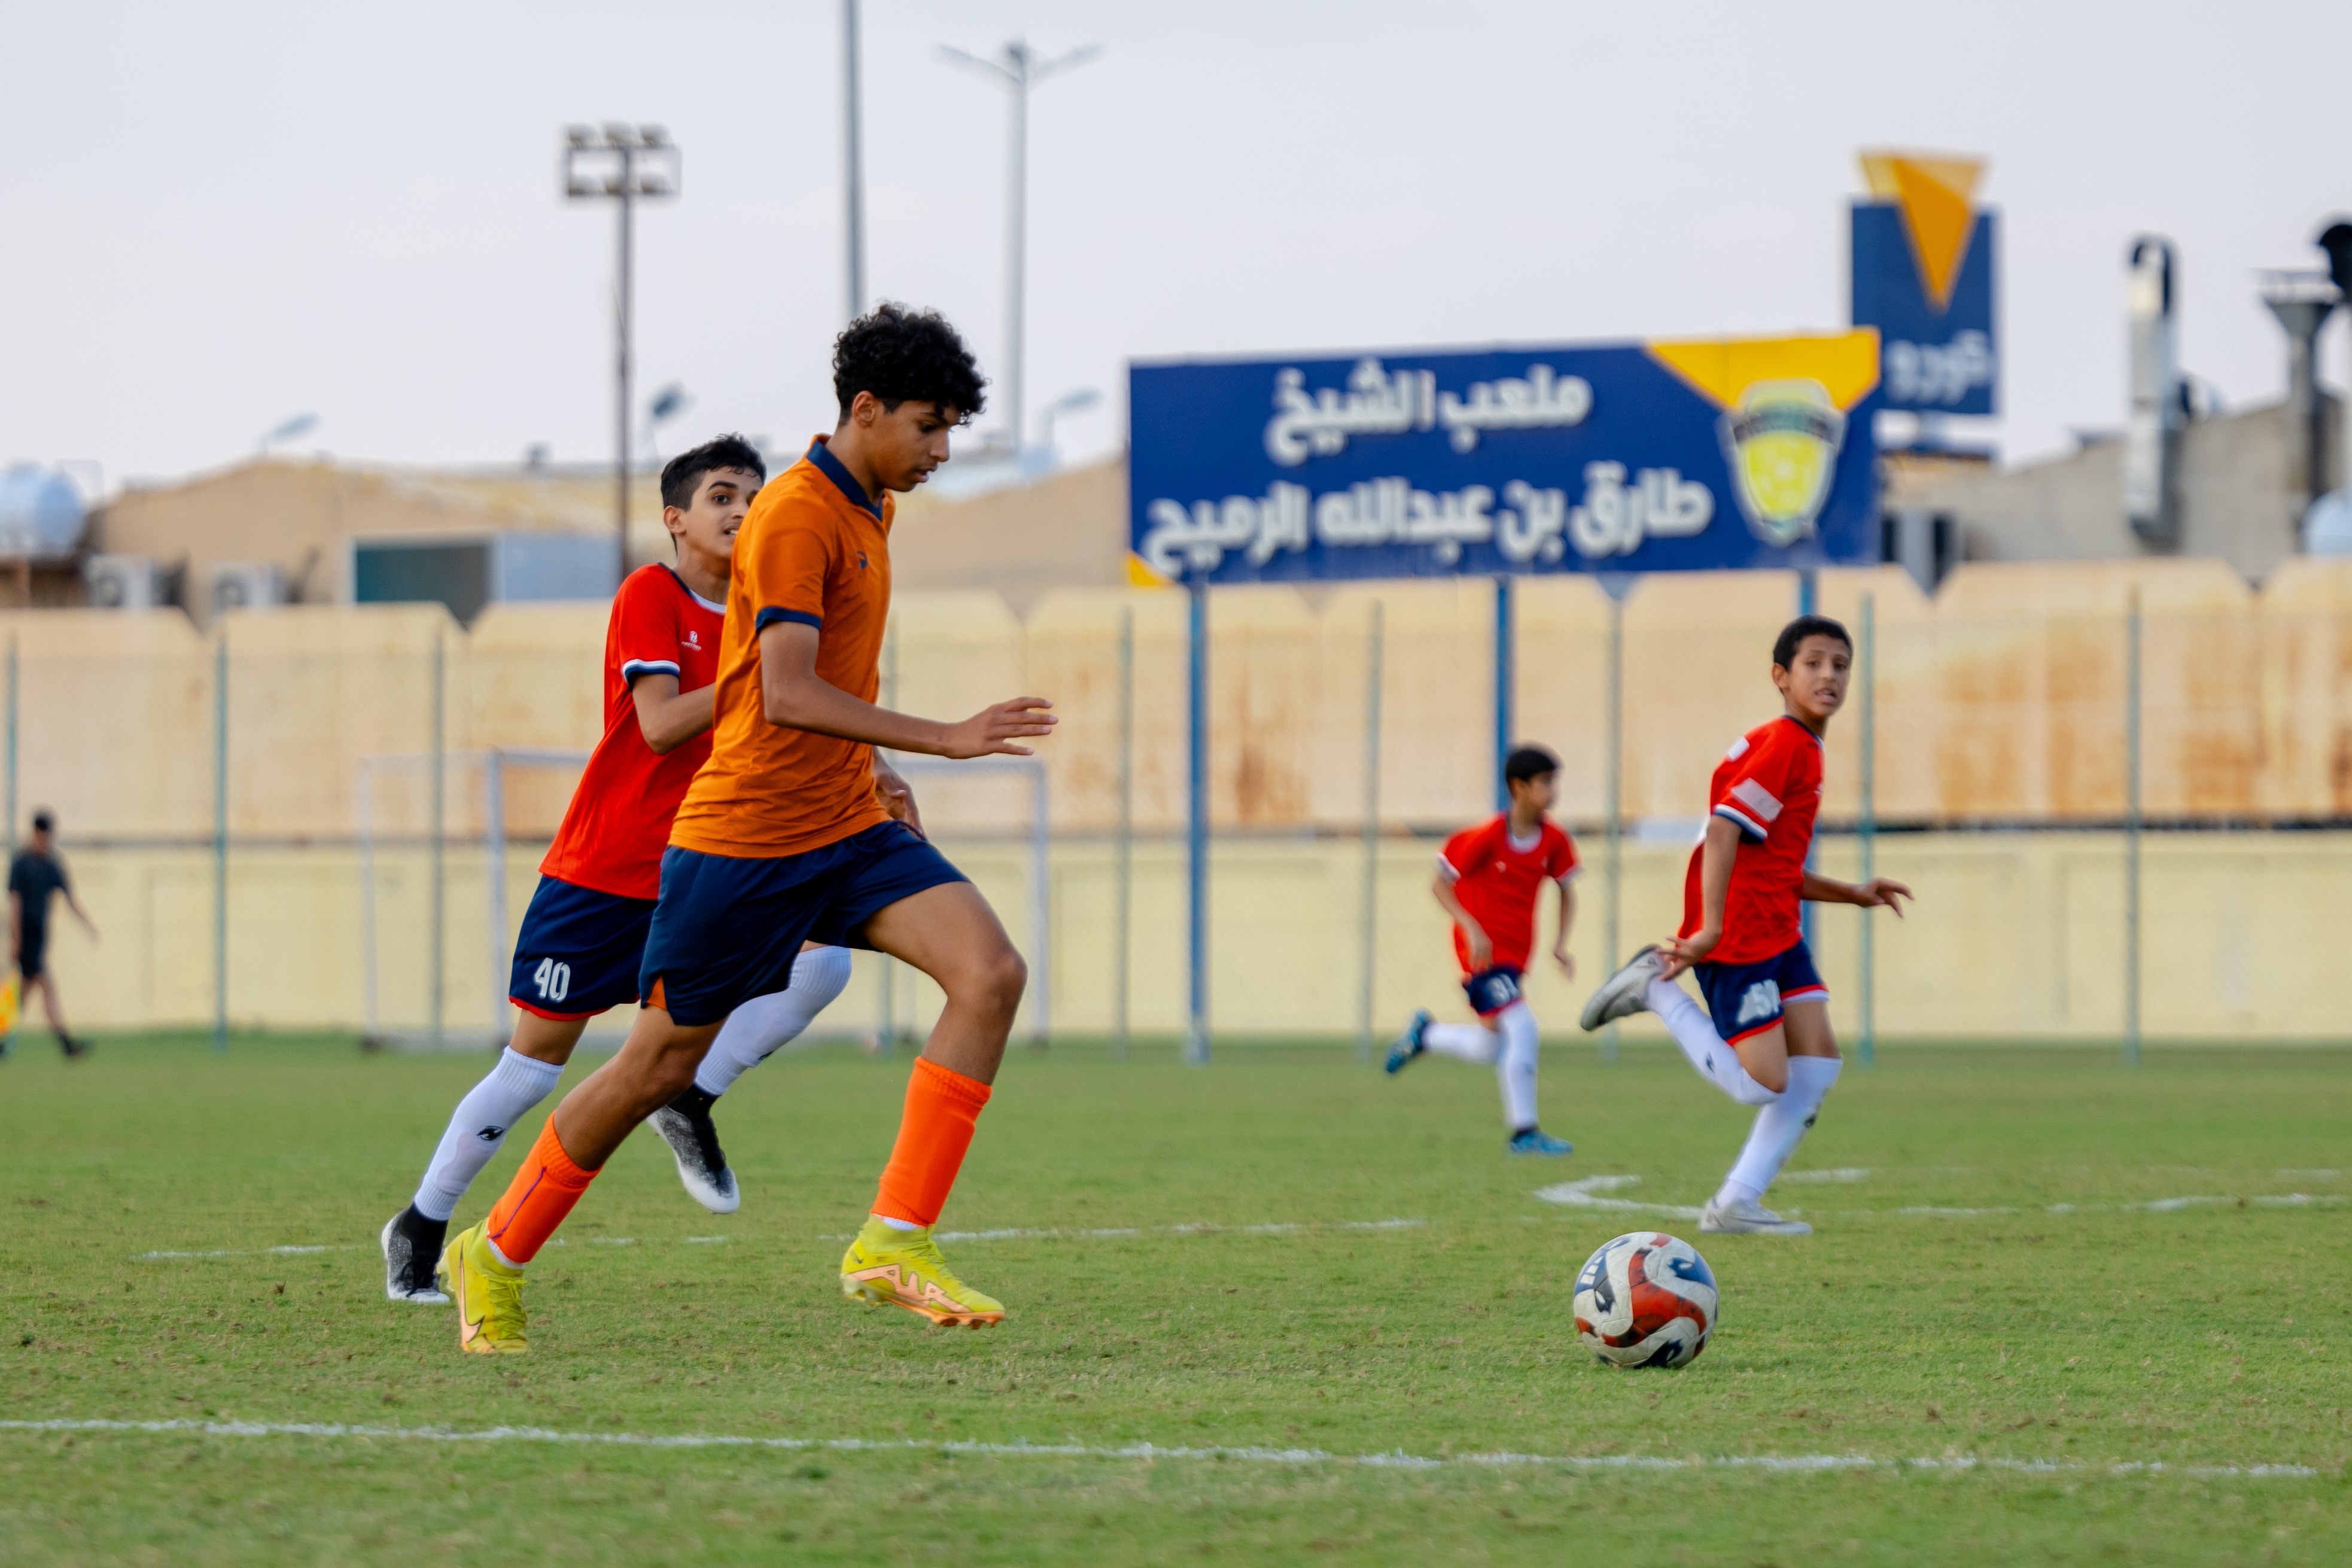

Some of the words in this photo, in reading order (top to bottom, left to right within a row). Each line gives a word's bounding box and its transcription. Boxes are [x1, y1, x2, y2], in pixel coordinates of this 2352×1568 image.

[1264, 357, 1435, 466] الشيخ
[1437, 363, 1594, 454] ملعب
[1141, 480, 1310, 579] الرميح
[1497, 479, 1566, 562] بن
[1571, 460, 1714, 559] طارق
[534, 957, 571, 1002] 40
